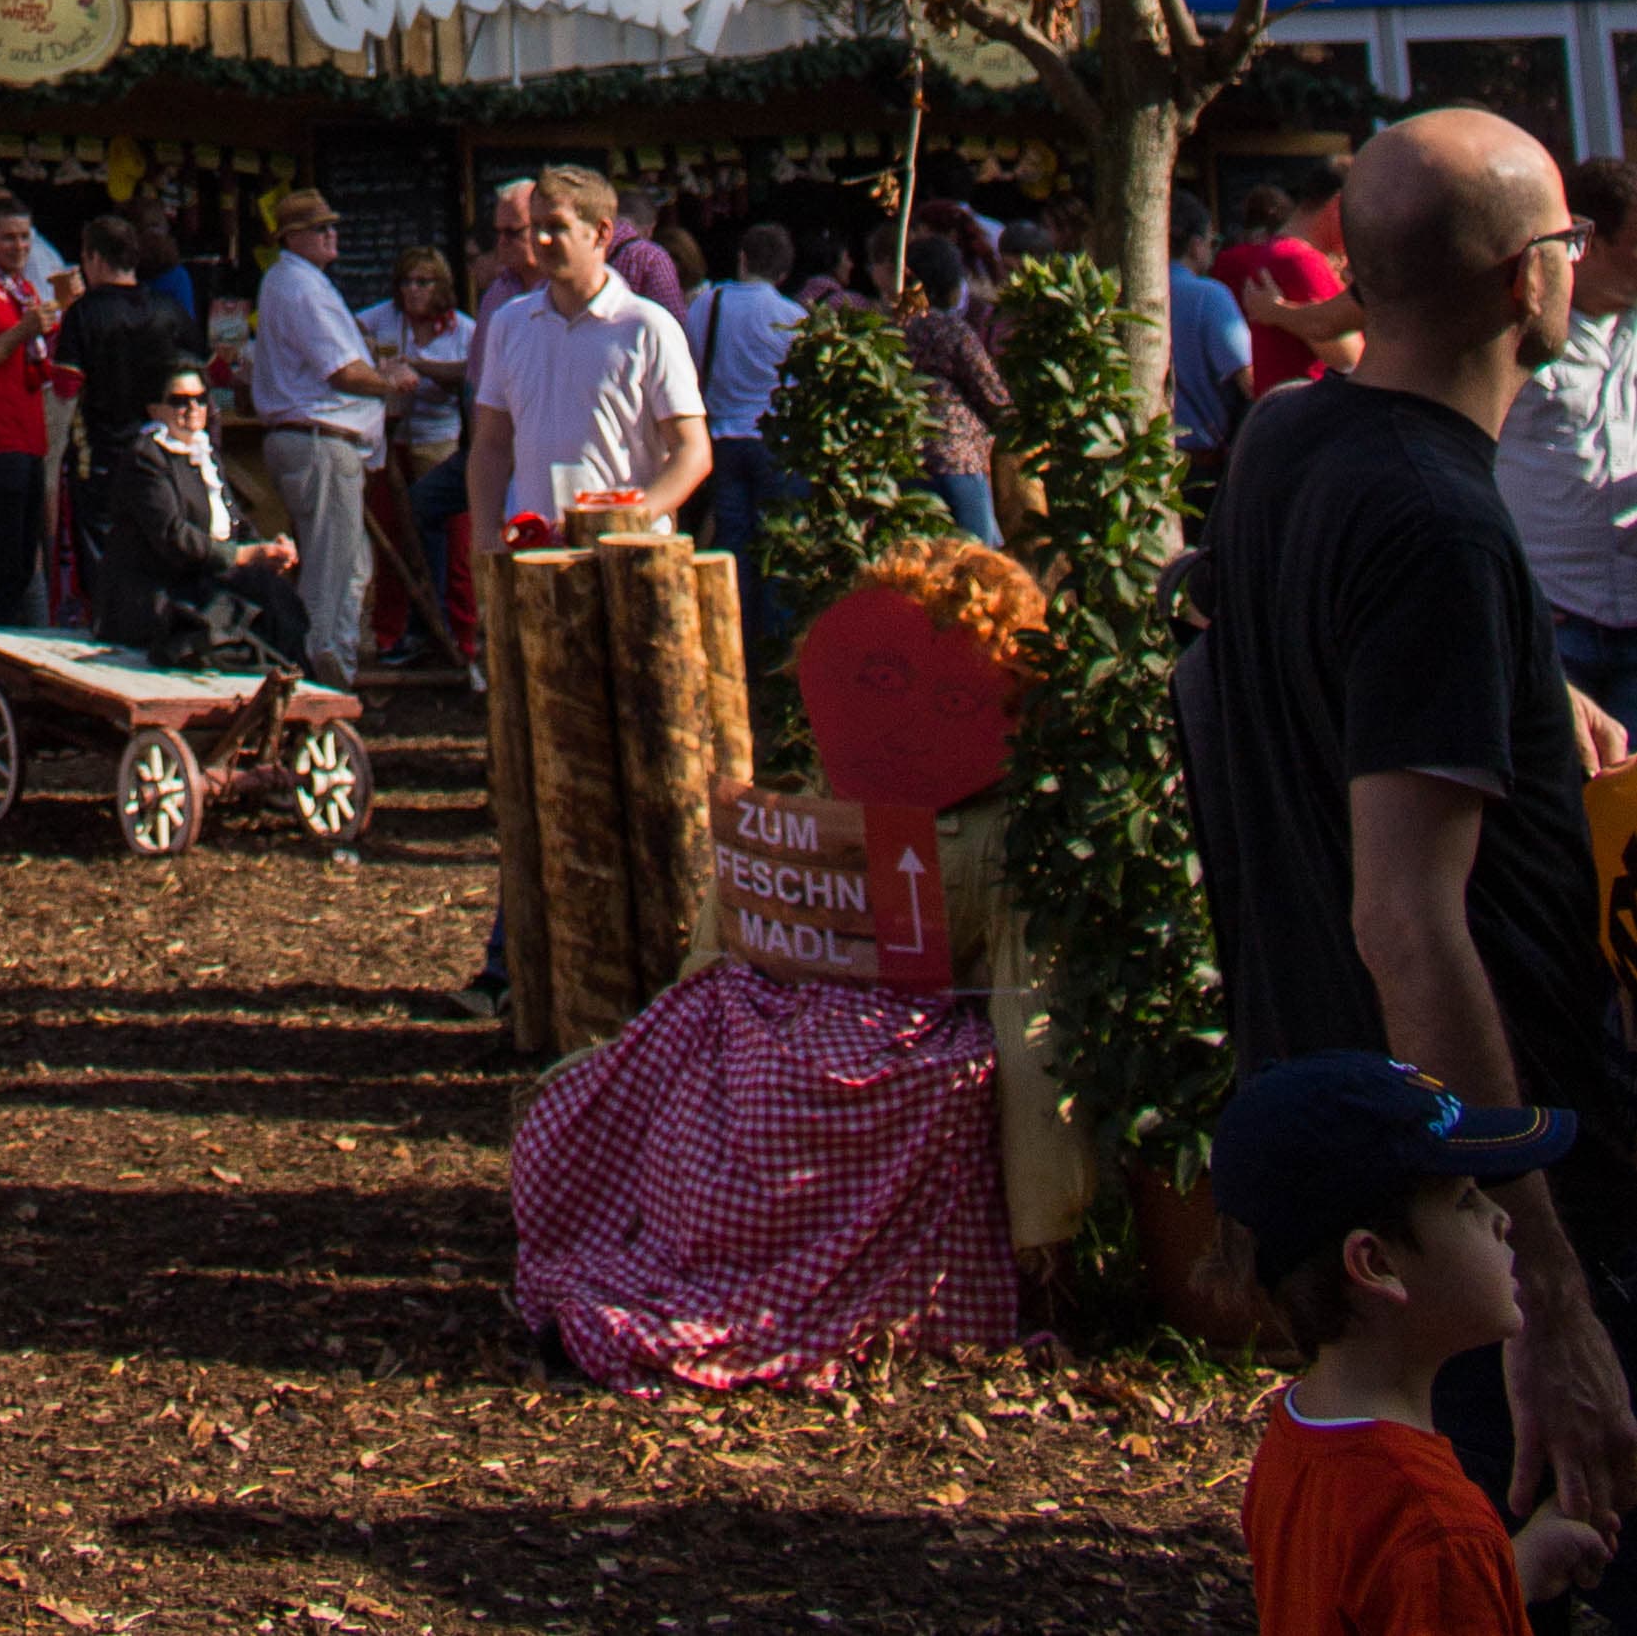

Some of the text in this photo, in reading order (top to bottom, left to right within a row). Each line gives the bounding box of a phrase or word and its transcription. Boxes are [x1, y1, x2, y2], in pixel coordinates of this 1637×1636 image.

[9, 40, 44, 64] und
[736, 799, 819, 852] ZUM
[715, 844, 866, 913] FESCHN
[739, 907, 853, 965] MADL
